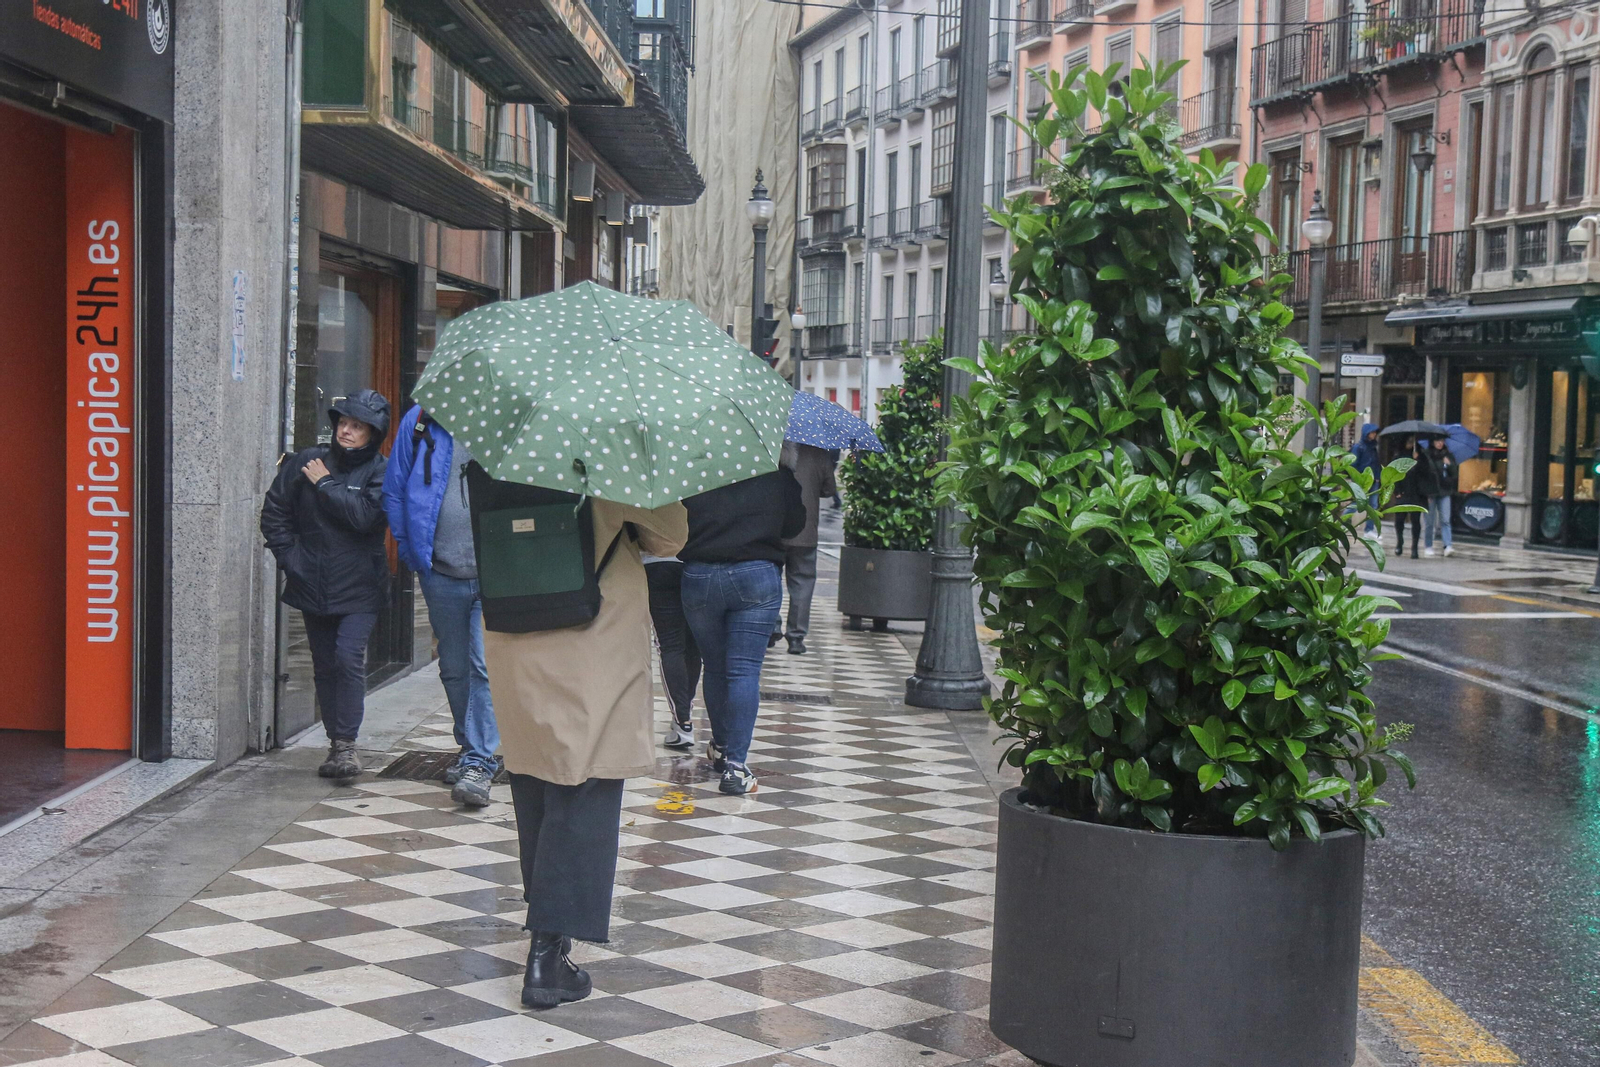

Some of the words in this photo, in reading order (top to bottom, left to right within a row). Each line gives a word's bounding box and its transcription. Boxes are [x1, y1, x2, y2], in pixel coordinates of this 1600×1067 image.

[32, 0, 60, 29] Tiendas
[60, 17, 102, 50] automáticas
[76, 220, 130, 642] www.picapica24h.es
